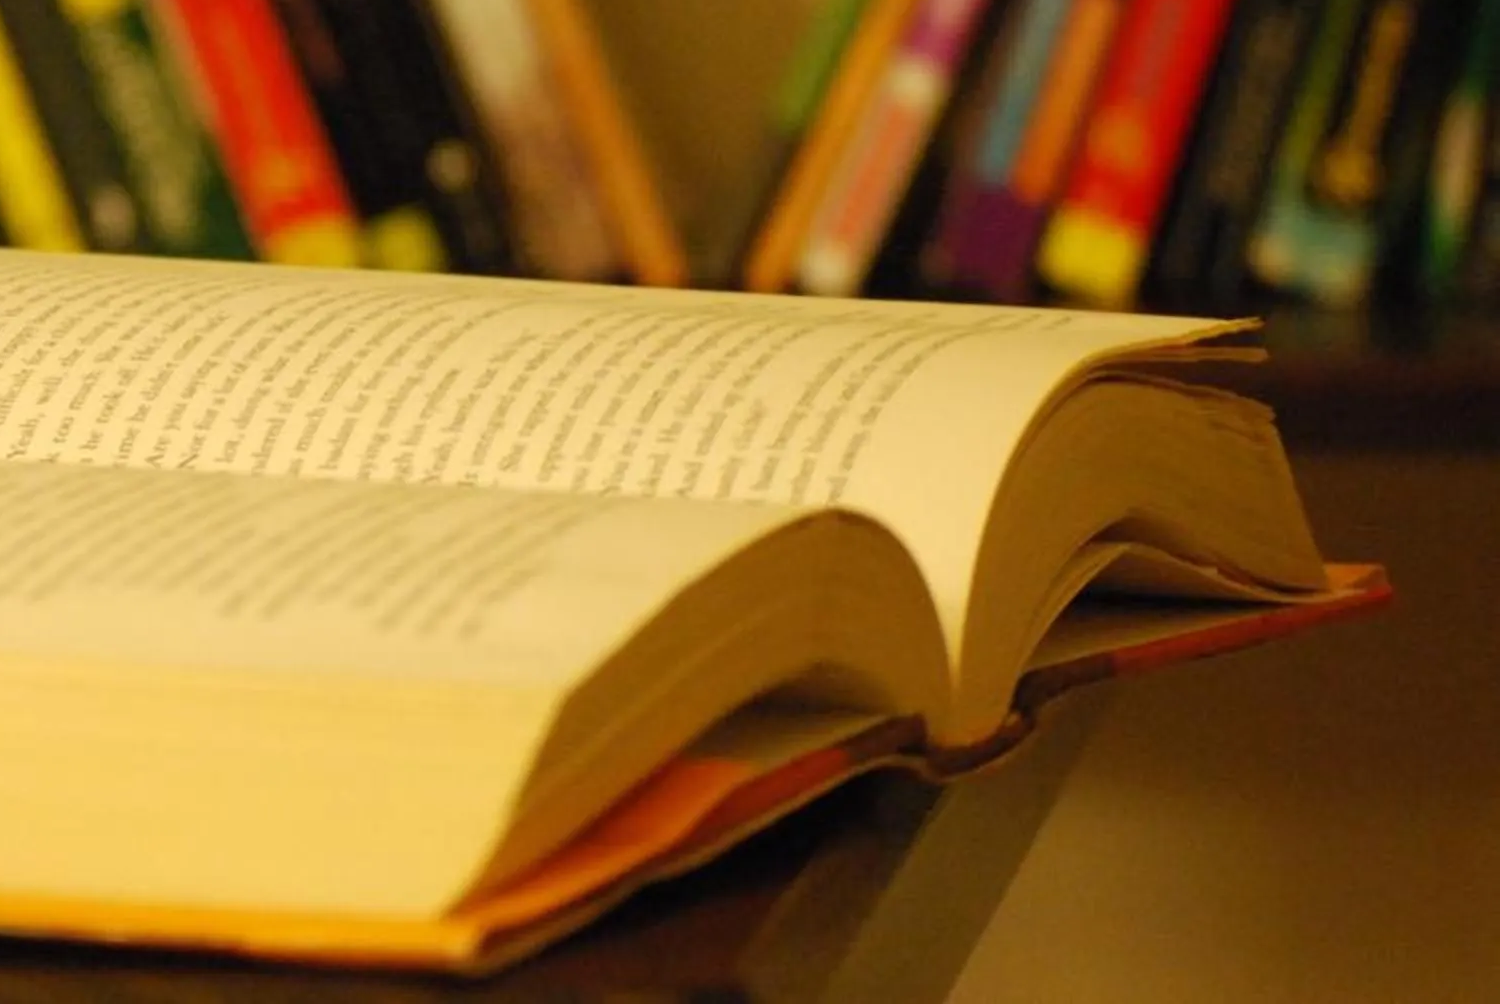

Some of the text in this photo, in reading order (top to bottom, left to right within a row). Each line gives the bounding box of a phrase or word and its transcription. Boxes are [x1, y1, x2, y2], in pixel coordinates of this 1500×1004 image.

[96, 389, 126, 424] took
[6, 413, 46, 459] Yeah,
[144, 435, 172, 470] Are
